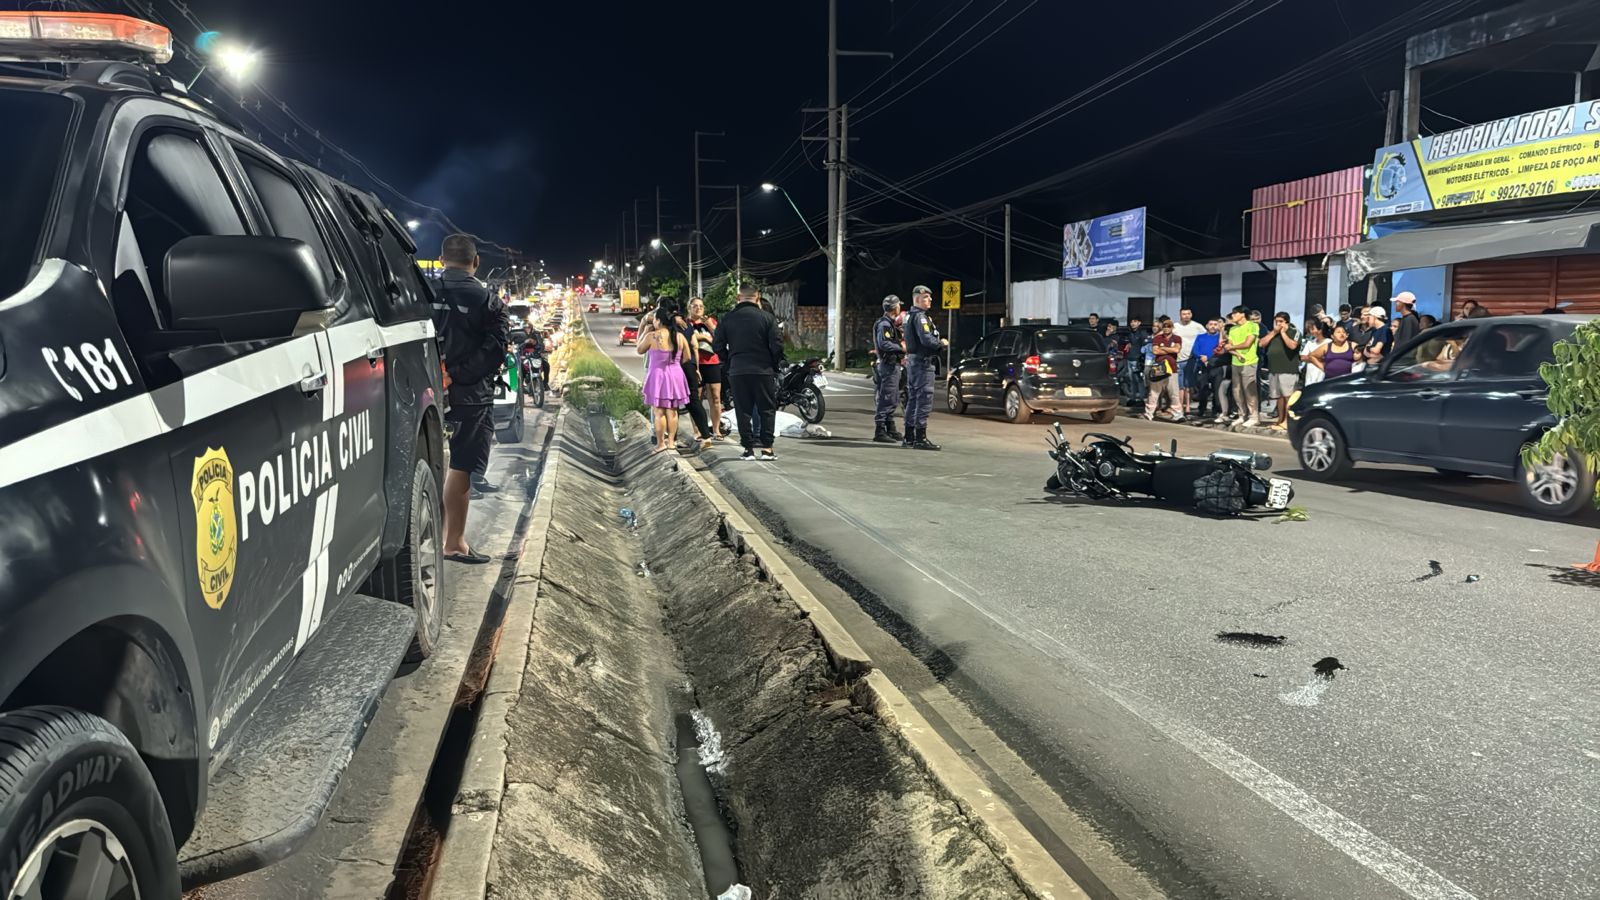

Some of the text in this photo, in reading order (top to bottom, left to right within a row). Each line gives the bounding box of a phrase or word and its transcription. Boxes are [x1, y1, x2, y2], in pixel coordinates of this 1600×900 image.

[1427, 105, 1576, 160] REBOBINADORA
[1427, 163, 1457, 176] MANUTENÇÃO
[1464, 160, 1483, 169] PADARIA
[1493, 156, 1510, 164] GERAL
[1519, 148, 1548, 159] COMANDO
[1550, 142, 1582, 154] ELÉTRICO
[1446, 173, 1473, 185] MOTORES
[1474, 168, 1509, 180] ELÉTRICOS
[1517, 162, 1548, 173] LIMPEZA
[1550, 160, 1561, 168] DE
[1563, 157, 1584, 167] POÇO
[1586, 154, 1600, 164] AN
[1497, 180, 1554, 200] 99227-9716
[62, 337, 133, 394] 181
[199, 461, 228, 490] POLÍCIA
[238, 408, 374, 542] POLÍCIA CIVIL
[210, 570, 229, 592] CIVIL
